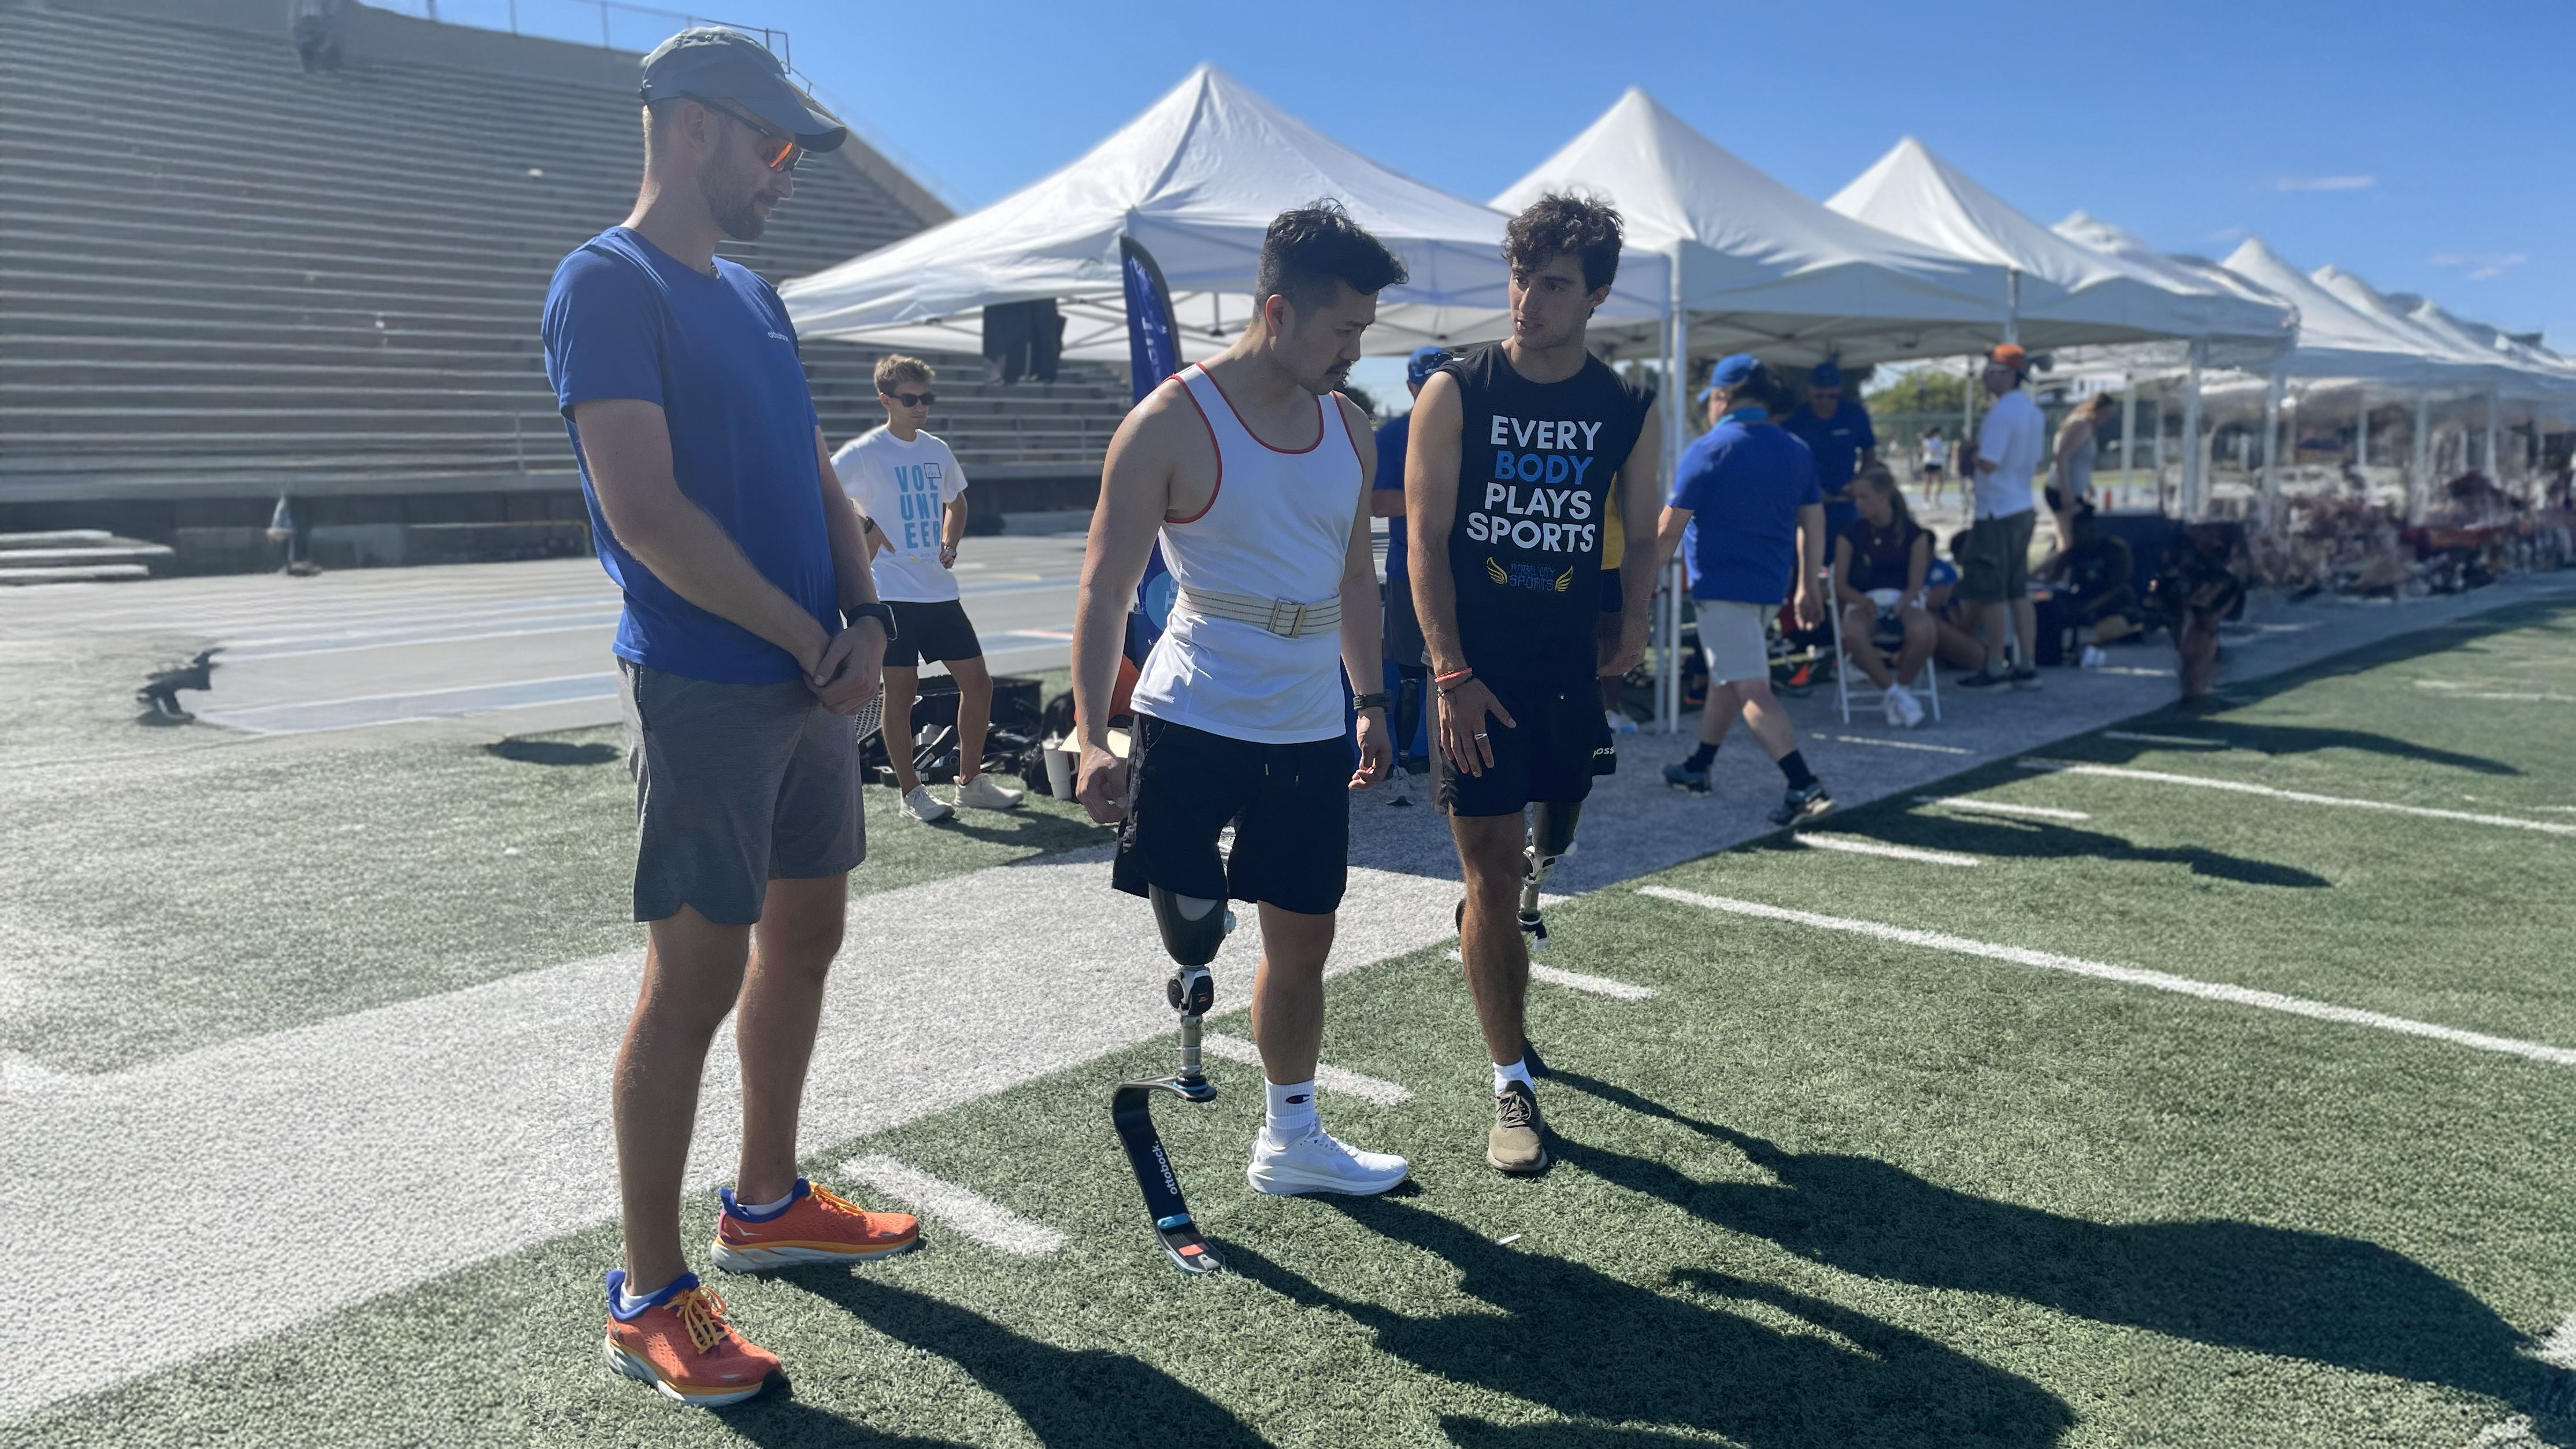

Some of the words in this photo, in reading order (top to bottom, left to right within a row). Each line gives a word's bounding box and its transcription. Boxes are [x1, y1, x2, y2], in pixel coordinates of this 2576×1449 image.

[1491, 415, 1602, 450] EVERY
[1495, 450, 1593, 485] BODY
[900, 493, 939, 520] UNT
[1484, 482, 1592, 519] PLAYS
[905, 521, 940, 549] EER
[1466, 512, 1596, 552] SPORTS
